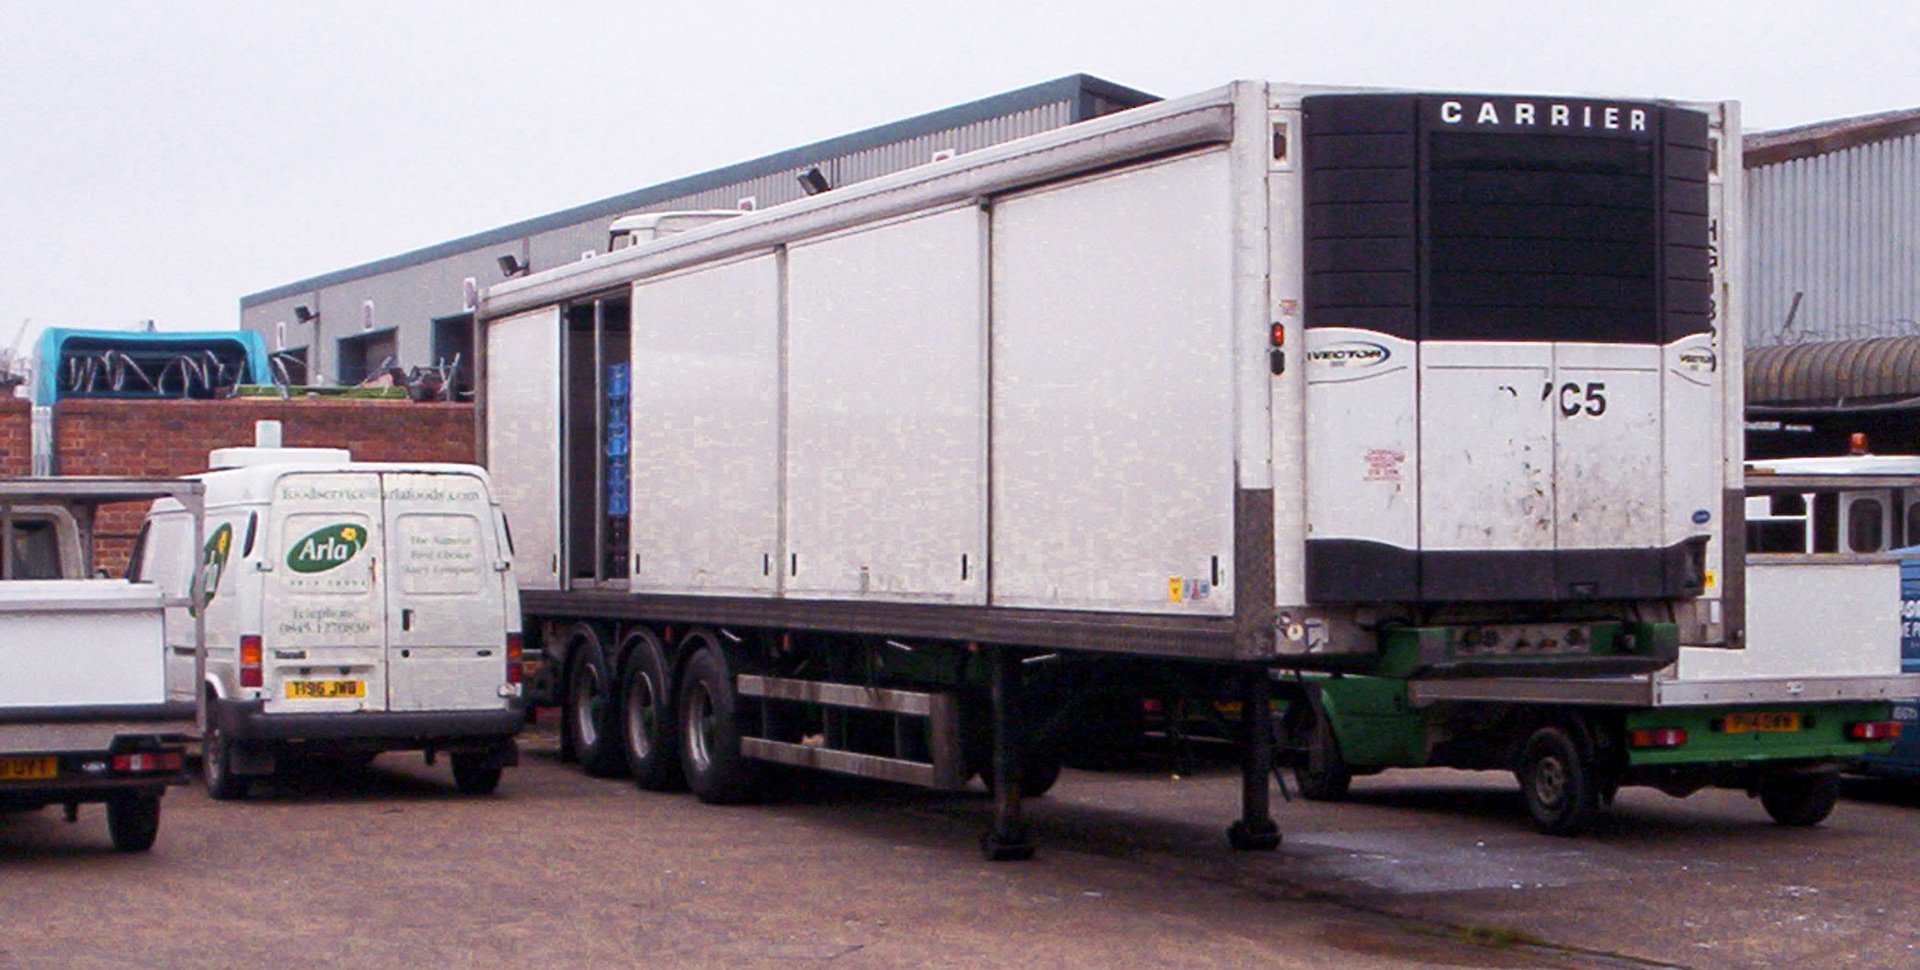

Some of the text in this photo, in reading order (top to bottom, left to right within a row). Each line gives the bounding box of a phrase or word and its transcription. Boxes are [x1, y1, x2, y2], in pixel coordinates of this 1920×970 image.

[1440, 100, 1646, 132] CARRIER
[1542, 382, 1607, 417] C5
[298, 536, 348, 561] Arla
